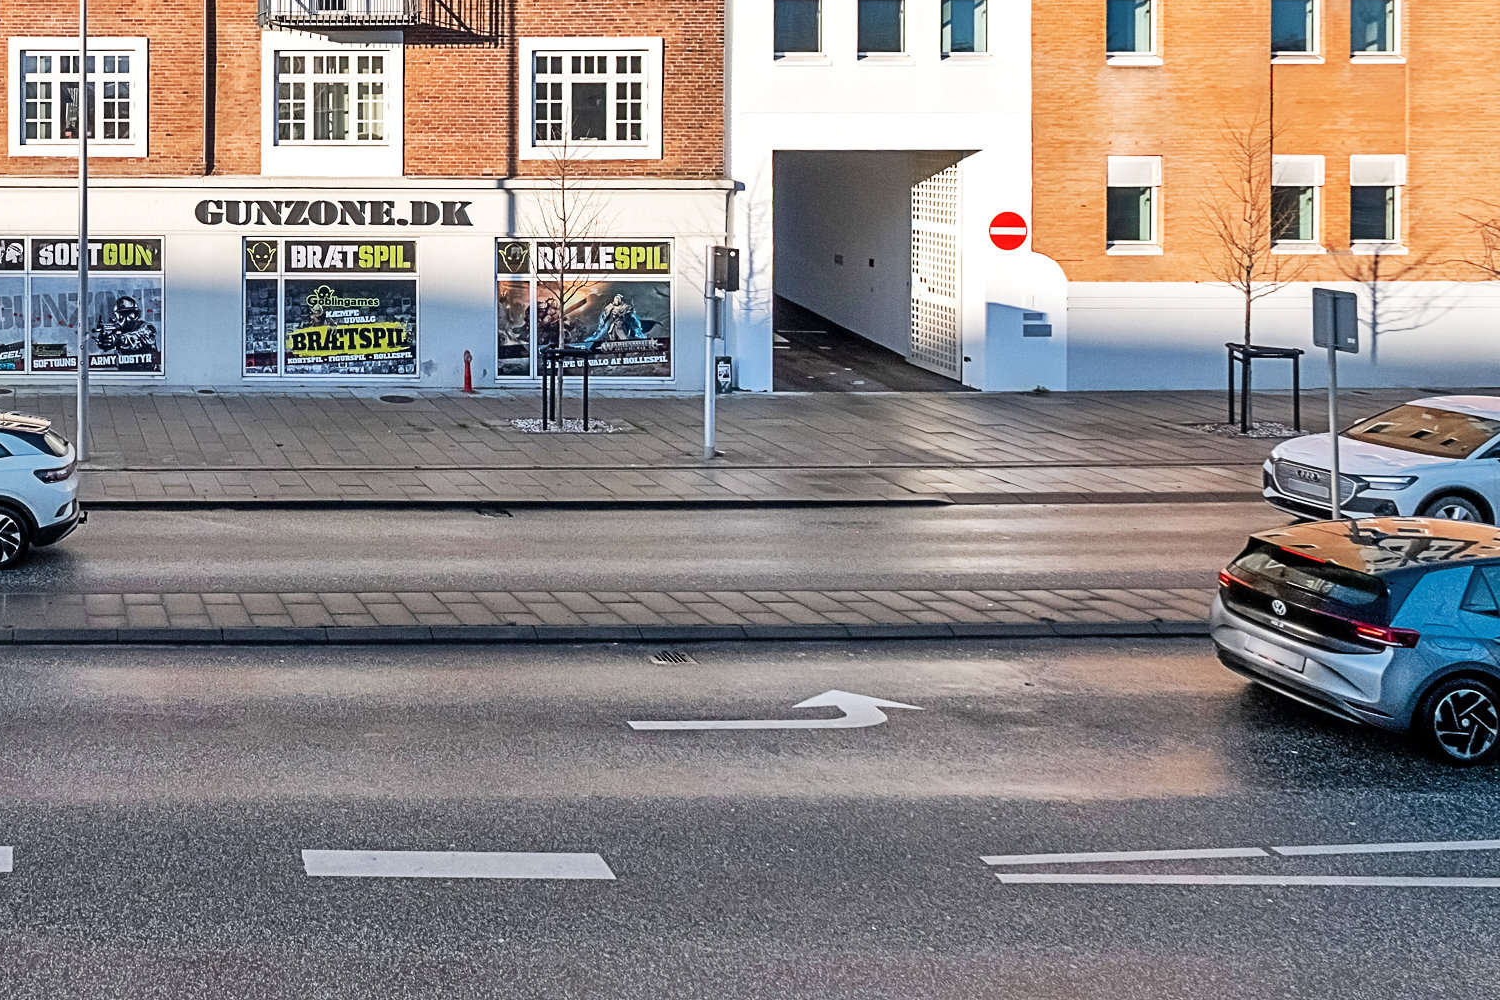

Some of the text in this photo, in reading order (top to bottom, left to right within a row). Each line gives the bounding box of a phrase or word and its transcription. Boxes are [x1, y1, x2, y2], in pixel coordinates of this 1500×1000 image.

[194, 199, 474, 226] GUNZONE.DK
[291, 245, 411, 268] BRÆTSPIL
[538, 246, 668, 270] ROLLESPIL
[306, 295, 380, 307] Goblingames
[33, 353, 152, 368] SOFTGUNS ARMY UDSTYR
[623, 355, 668, 364] ROLLESPIL
